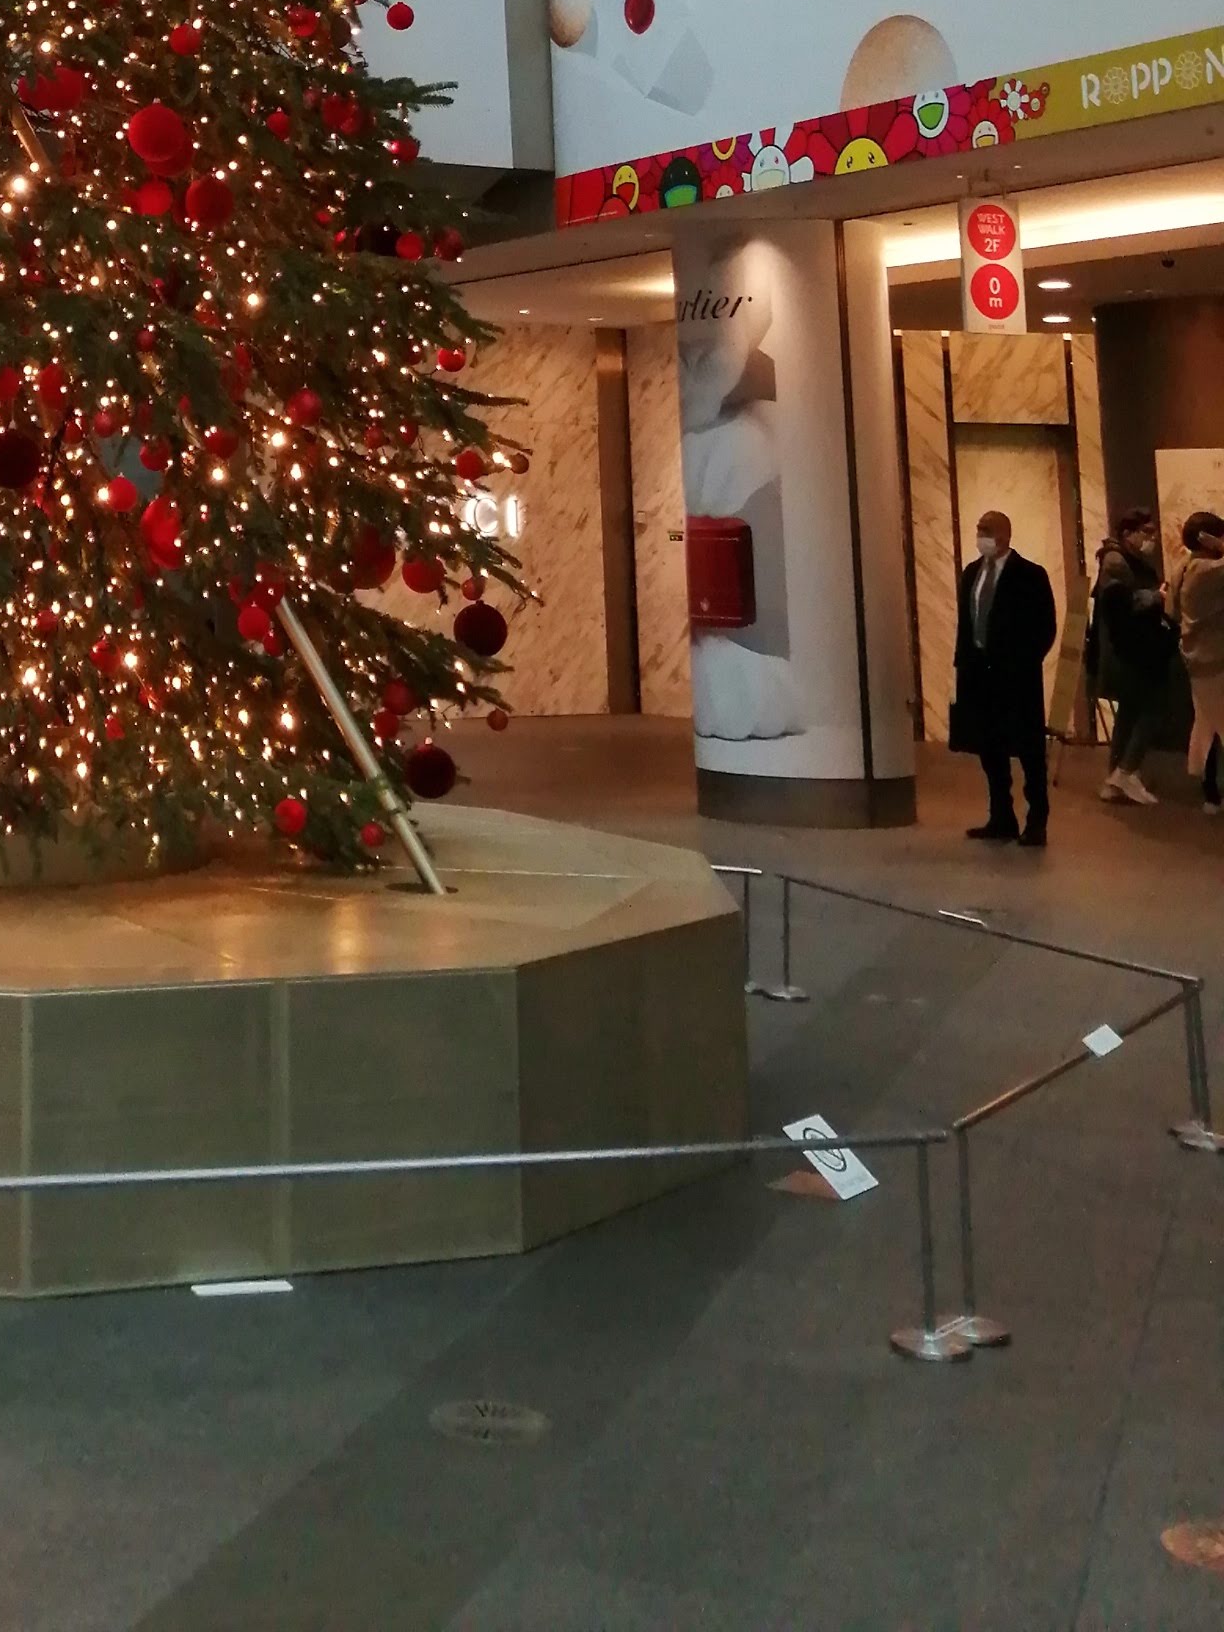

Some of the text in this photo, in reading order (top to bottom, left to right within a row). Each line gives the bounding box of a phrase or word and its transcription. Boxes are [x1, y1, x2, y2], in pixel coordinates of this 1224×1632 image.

[976, 213, 1005, 224] WEST
[977, 224, 1006, 236] WALK
[984, 238, 1001, 253] 2F
[988, 277, 1001, 295] 0
[677, 289, 752, 322] rtier
[988, 297, 1003, 308] m
